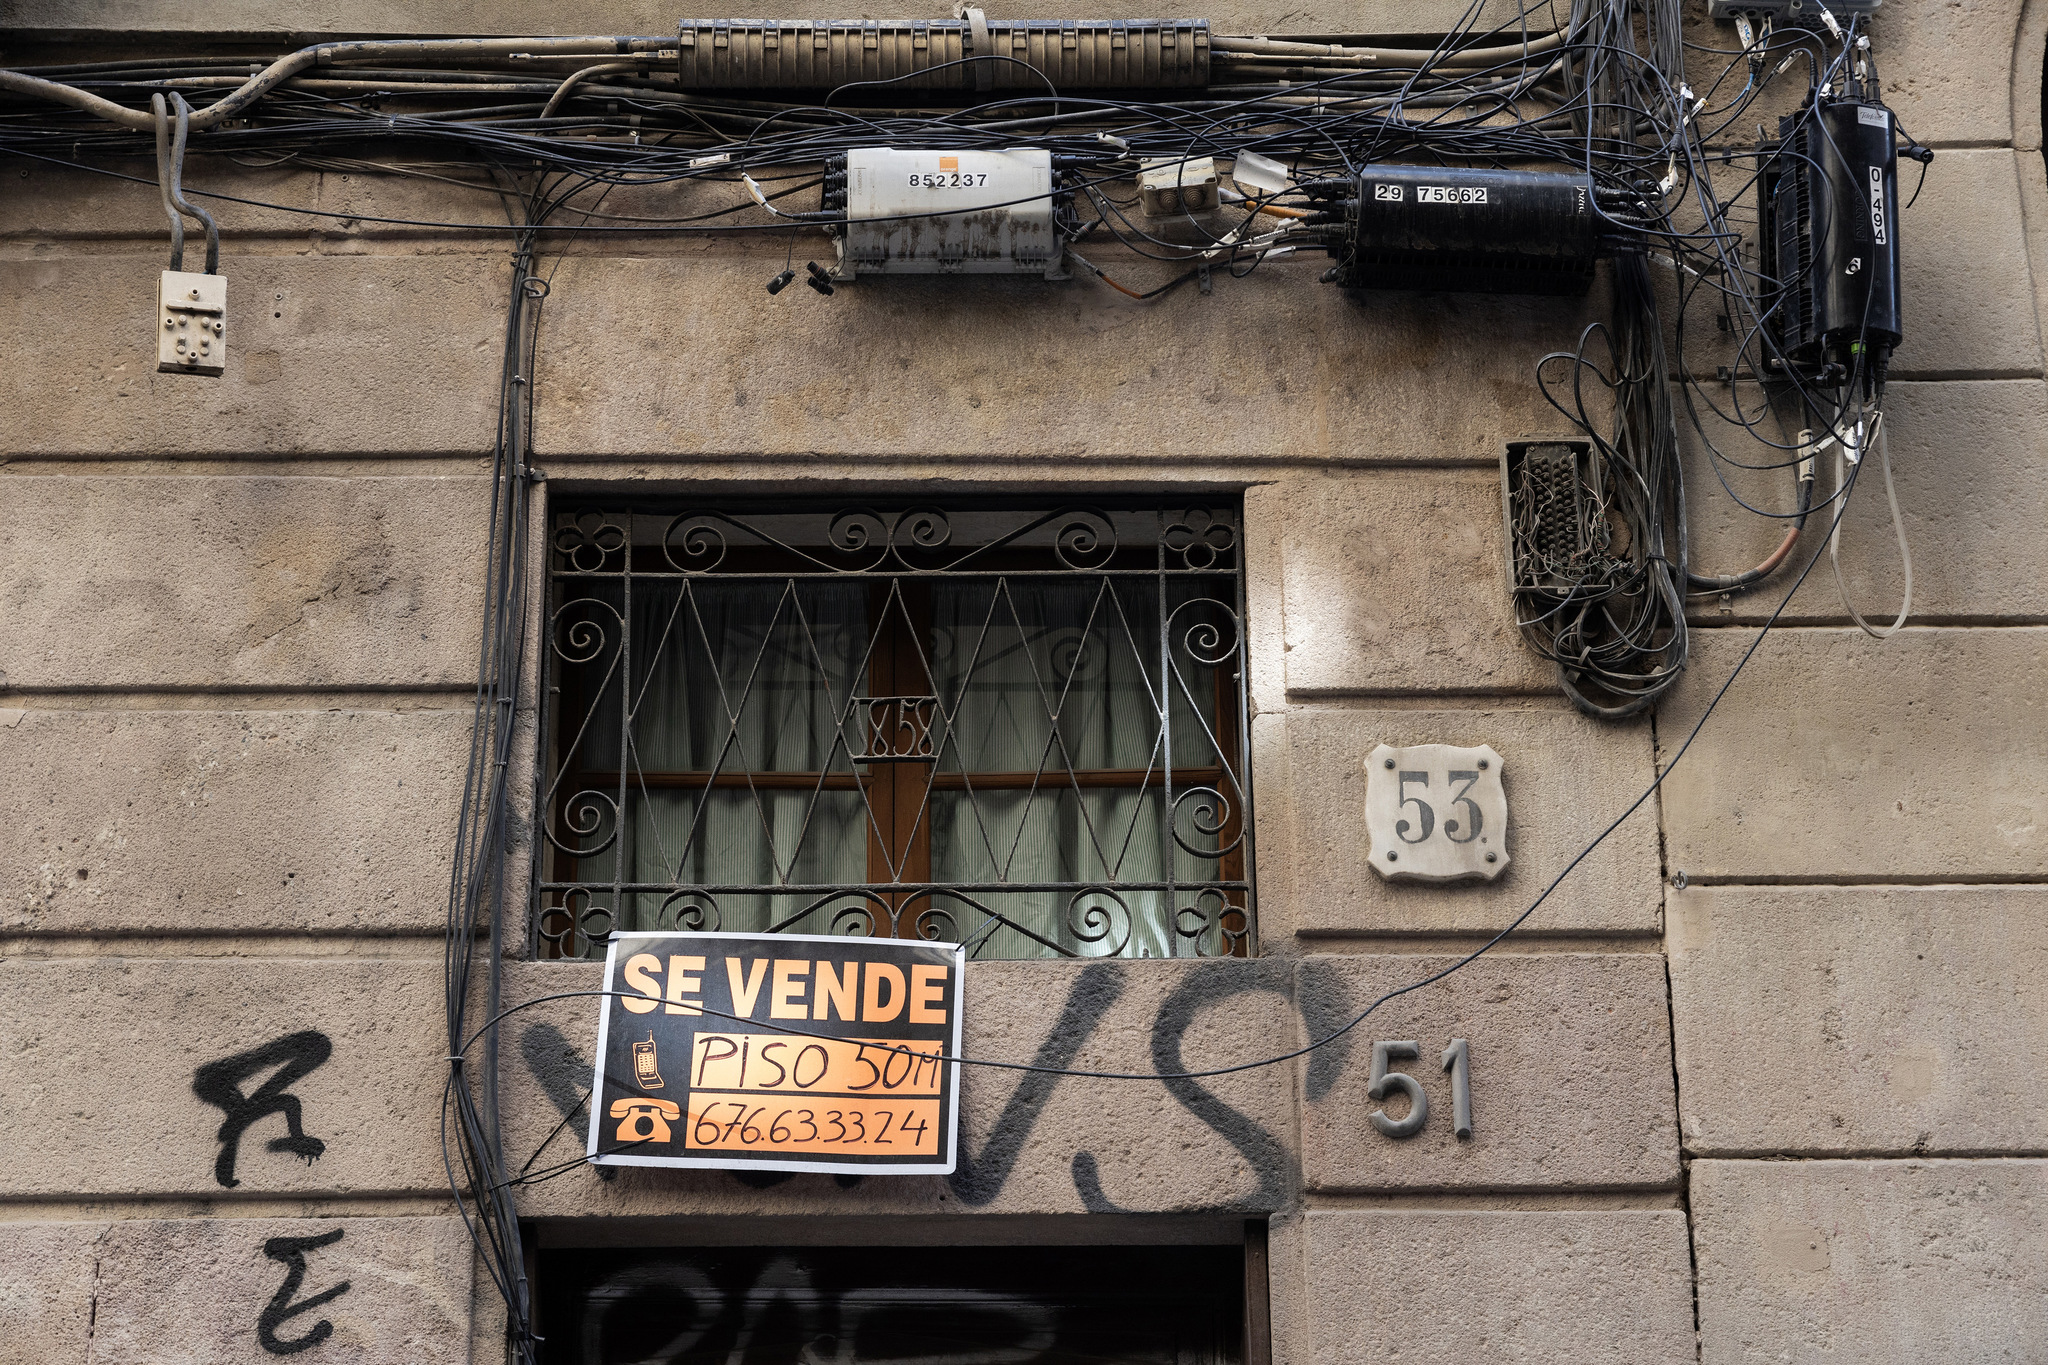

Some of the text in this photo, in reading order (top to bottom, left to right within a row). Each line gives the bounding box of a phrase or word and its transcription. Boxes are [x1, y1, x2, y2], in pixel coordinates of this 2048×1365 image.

[909, 174, 987, 187] 852237
[1377, 185, 1486, 202] 29 75662
[1395, 770, 1484, 844] 53
[621, 953, 948, 1025] SE VENDE
[1368, 1038, 1472, 1138] 51
